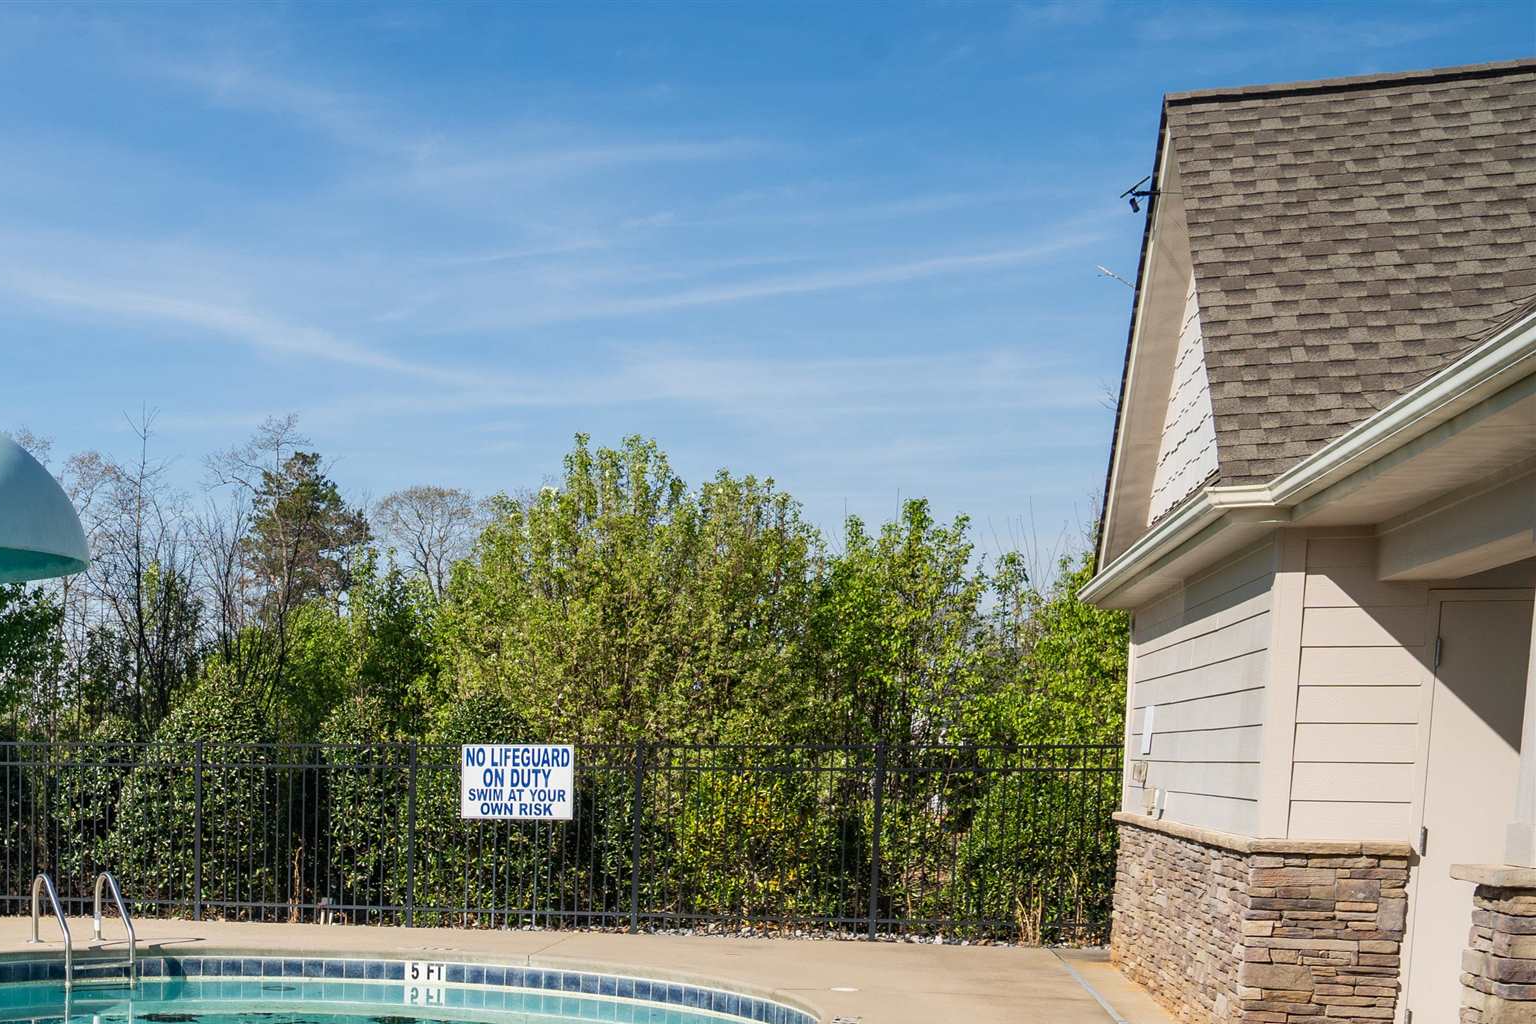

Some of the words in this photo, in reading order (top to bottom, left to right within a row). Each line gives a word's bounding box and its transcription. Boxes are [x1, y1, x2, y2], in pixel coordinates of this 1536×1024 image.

[466, 747, 485, 767] NO
[491, 747, 570, 767] LIFEGUARD
[483, 768, 504, 787] ON
[510, 769, 551, 788] DUTY
[468, 788, 503, 801] SWIM
[508, 789, 524, 801] AT
[529, 789, 566, 802] YOUR
[480, 803, 513, 815] OWN
[519, 803, 553, 816] RISK
[411, 962, 419, 980] 5
[427, 963, 444, 981] FT
